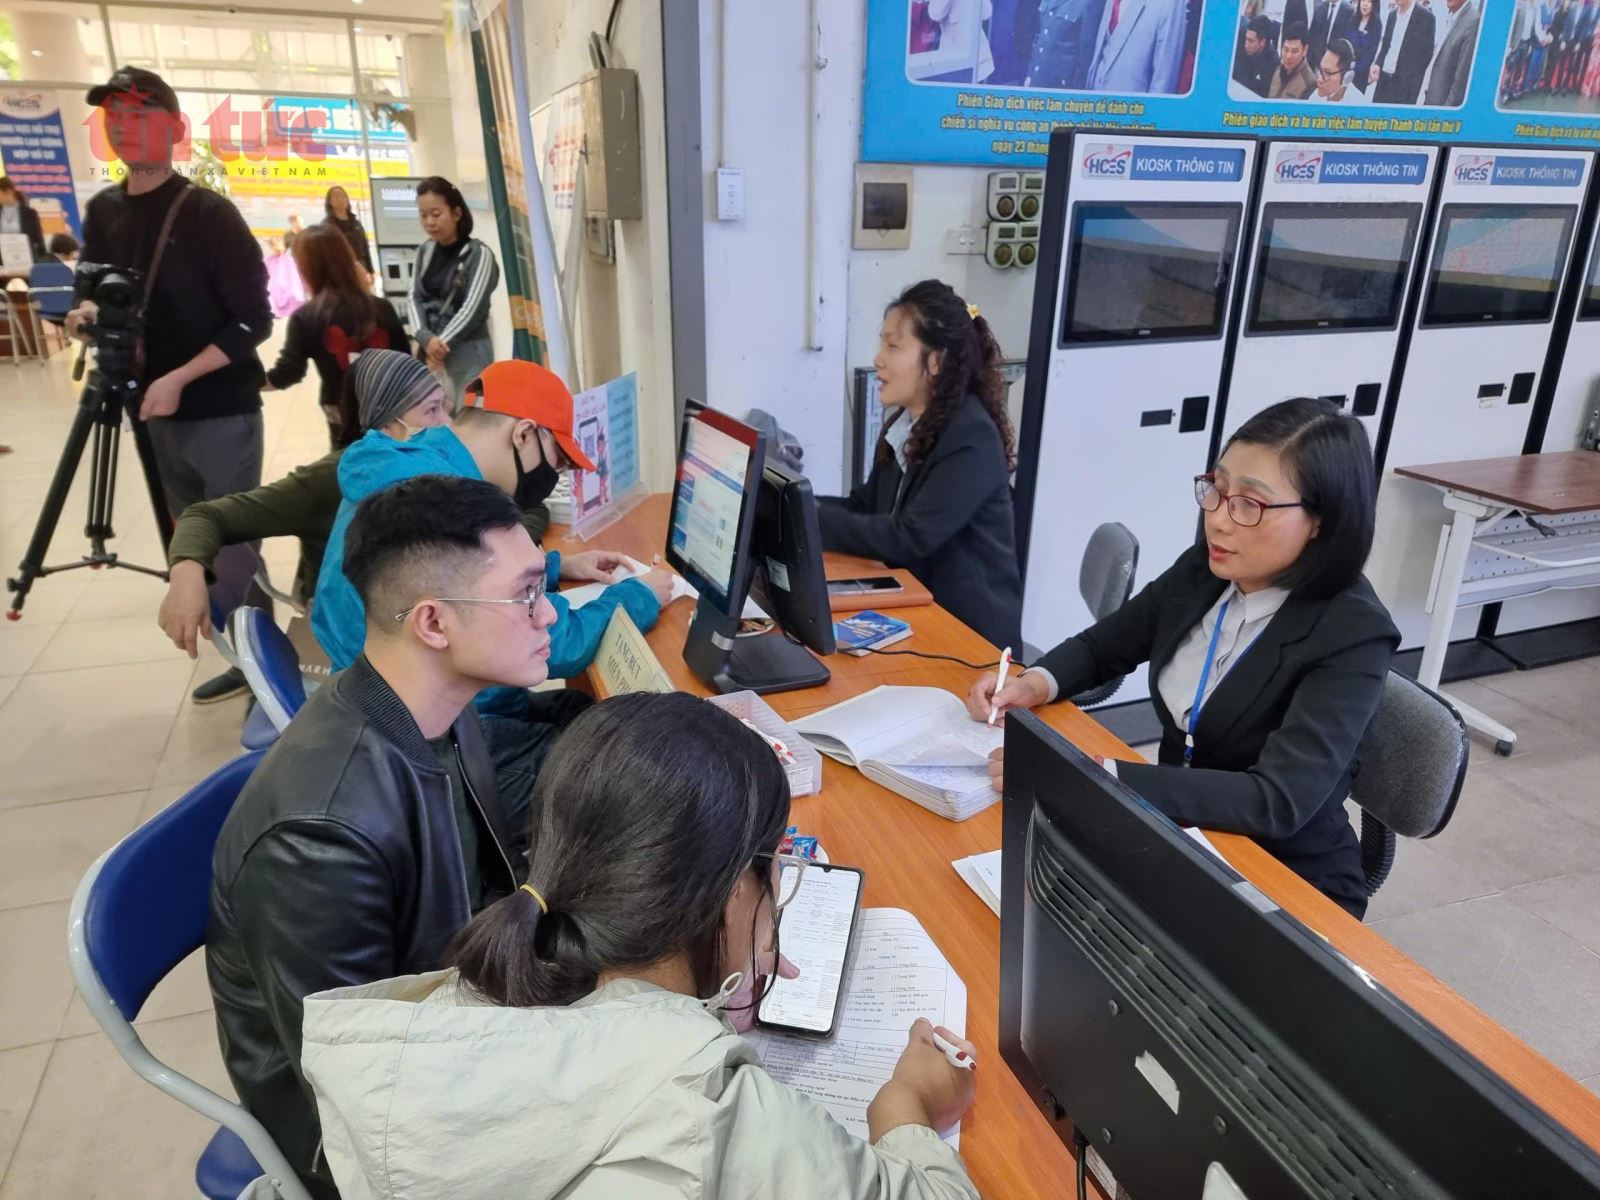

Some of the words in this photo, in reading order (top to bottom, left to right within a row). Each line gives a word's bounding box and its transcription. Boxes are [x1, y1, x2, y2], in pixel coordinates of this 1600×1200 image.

[957, 92, 982, 108] Phiên
[984, 94, 1003, 109] Giao
[1006, 95, 1024, 112] dịch
[1027, 97, 1045, 113] việc
[1046, 97, 1062, 111] làm
[1064, 98, 1093, 114] chuyên
[1129, 101, 1145, 116] cho
[941, 113, 965, 128] chiến
[1015, 118, 1037, 132] công
[1038, 121, 1049, 132] an
[1223, 112, 1248, 127] Phiên
[1249, 113, 1268, 128] giao
[1270, 113, 1288, 129] dịch
[1328, 115, 1345, 131] việc
[1390, 118, 1412, 131] Thanh
[992, 140, 1013, 154] ngày
[1014, 140, 1026, 153] 23
[1089, 158, 1126, 175] HCES
[1136, 158, 1173, 172] KIOSK
[1176, 157, 1214, 173] THÔNG
[1217, 161, 1234, 174] TIN
[1281, 164, 1316, 179] HCES
[1325, 163, 1360, 176] KIOSK
[1362, 161, 1398, 176] THÔNG
[1402, 165, 1419, 177] TIN
[1496, 166, 1526, 179] KIOSK
[1528, 166, 1560, 180] THÔNG
[1562, 168, 1577, 180] TIN
[1457, 167, 1489, 181] HCES
